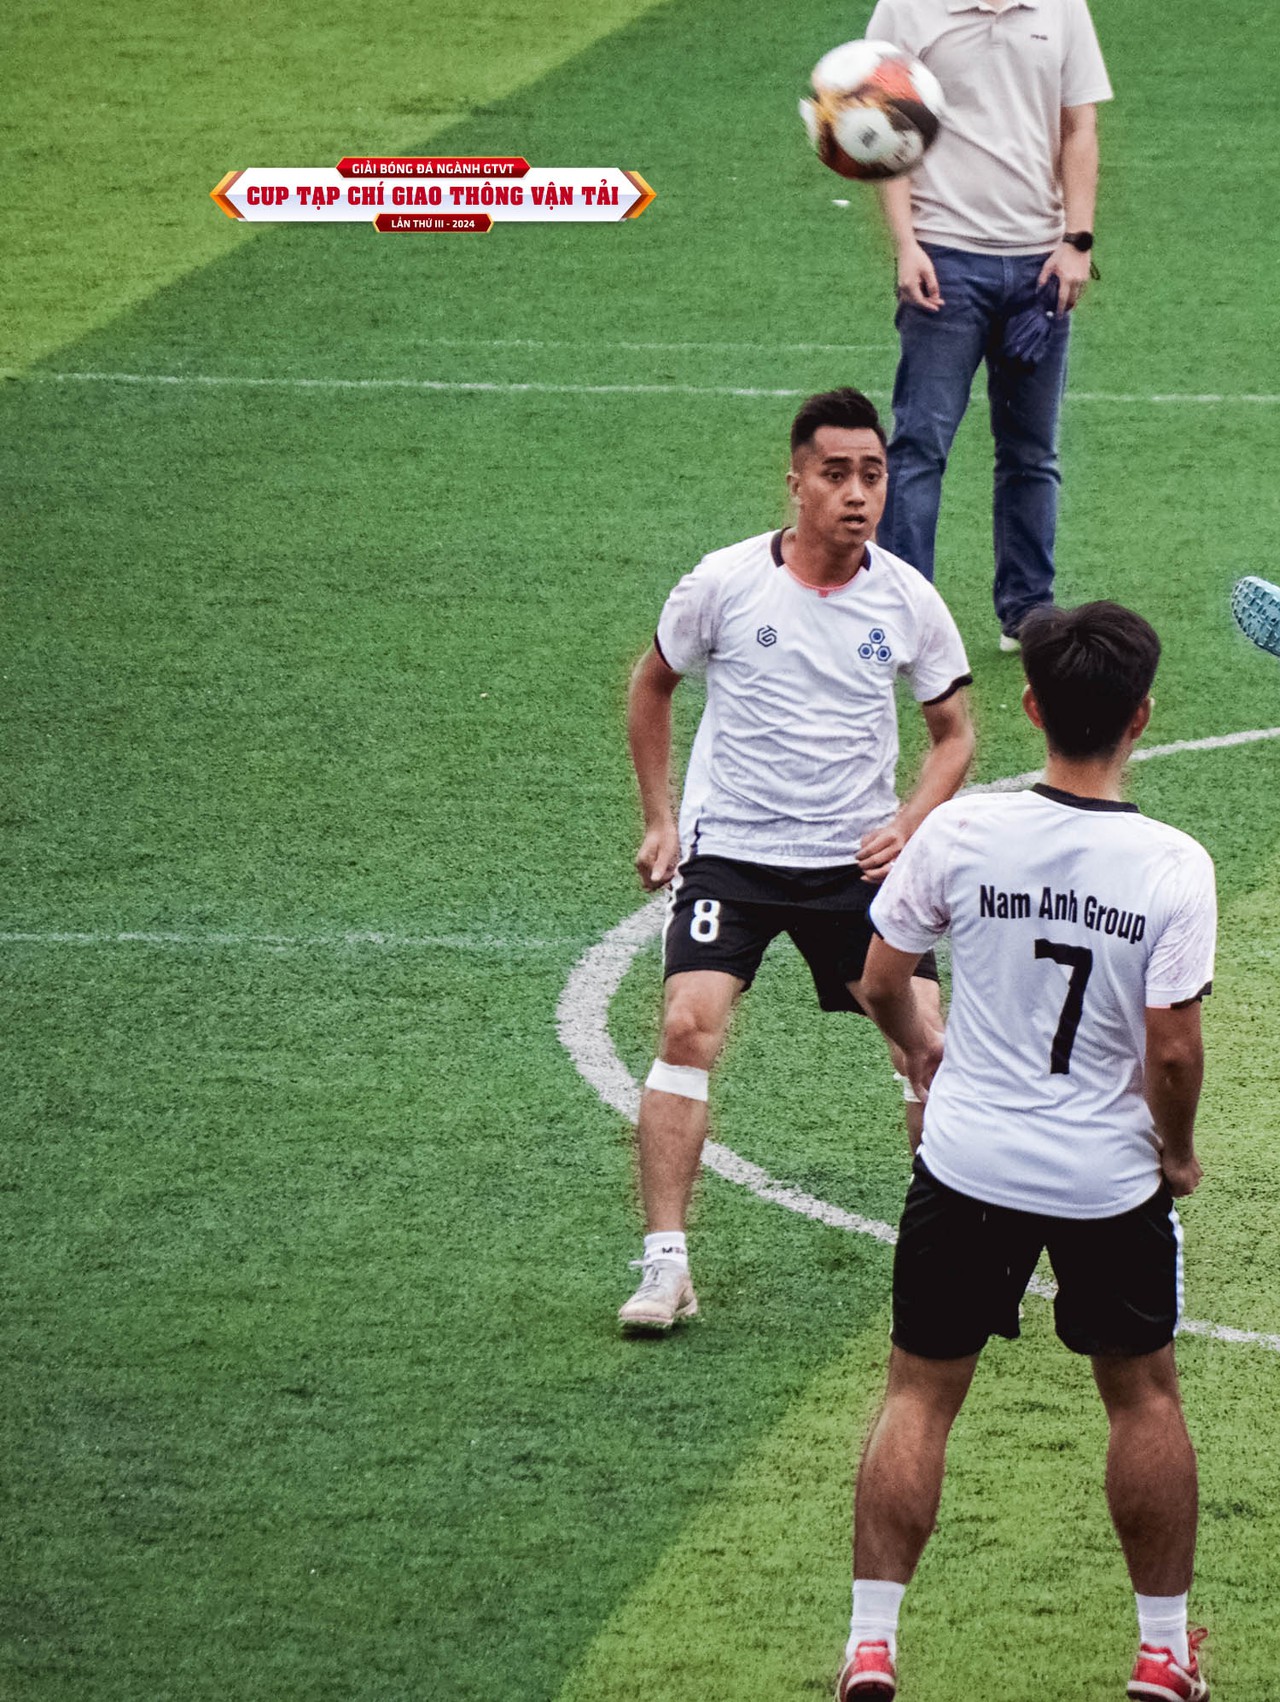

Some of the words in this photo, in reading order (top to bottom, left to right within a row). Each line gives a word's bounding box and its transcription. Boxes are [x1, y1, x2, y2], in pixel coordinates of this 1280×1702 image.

[690, 899, 721, 942] 8
[980, 885, 1031, 919] Nam
[1038, 887, 1077, 923] Anh
[1084, 895, 1146, 944] Group
[1034, 938, 1093, 1075] 7
